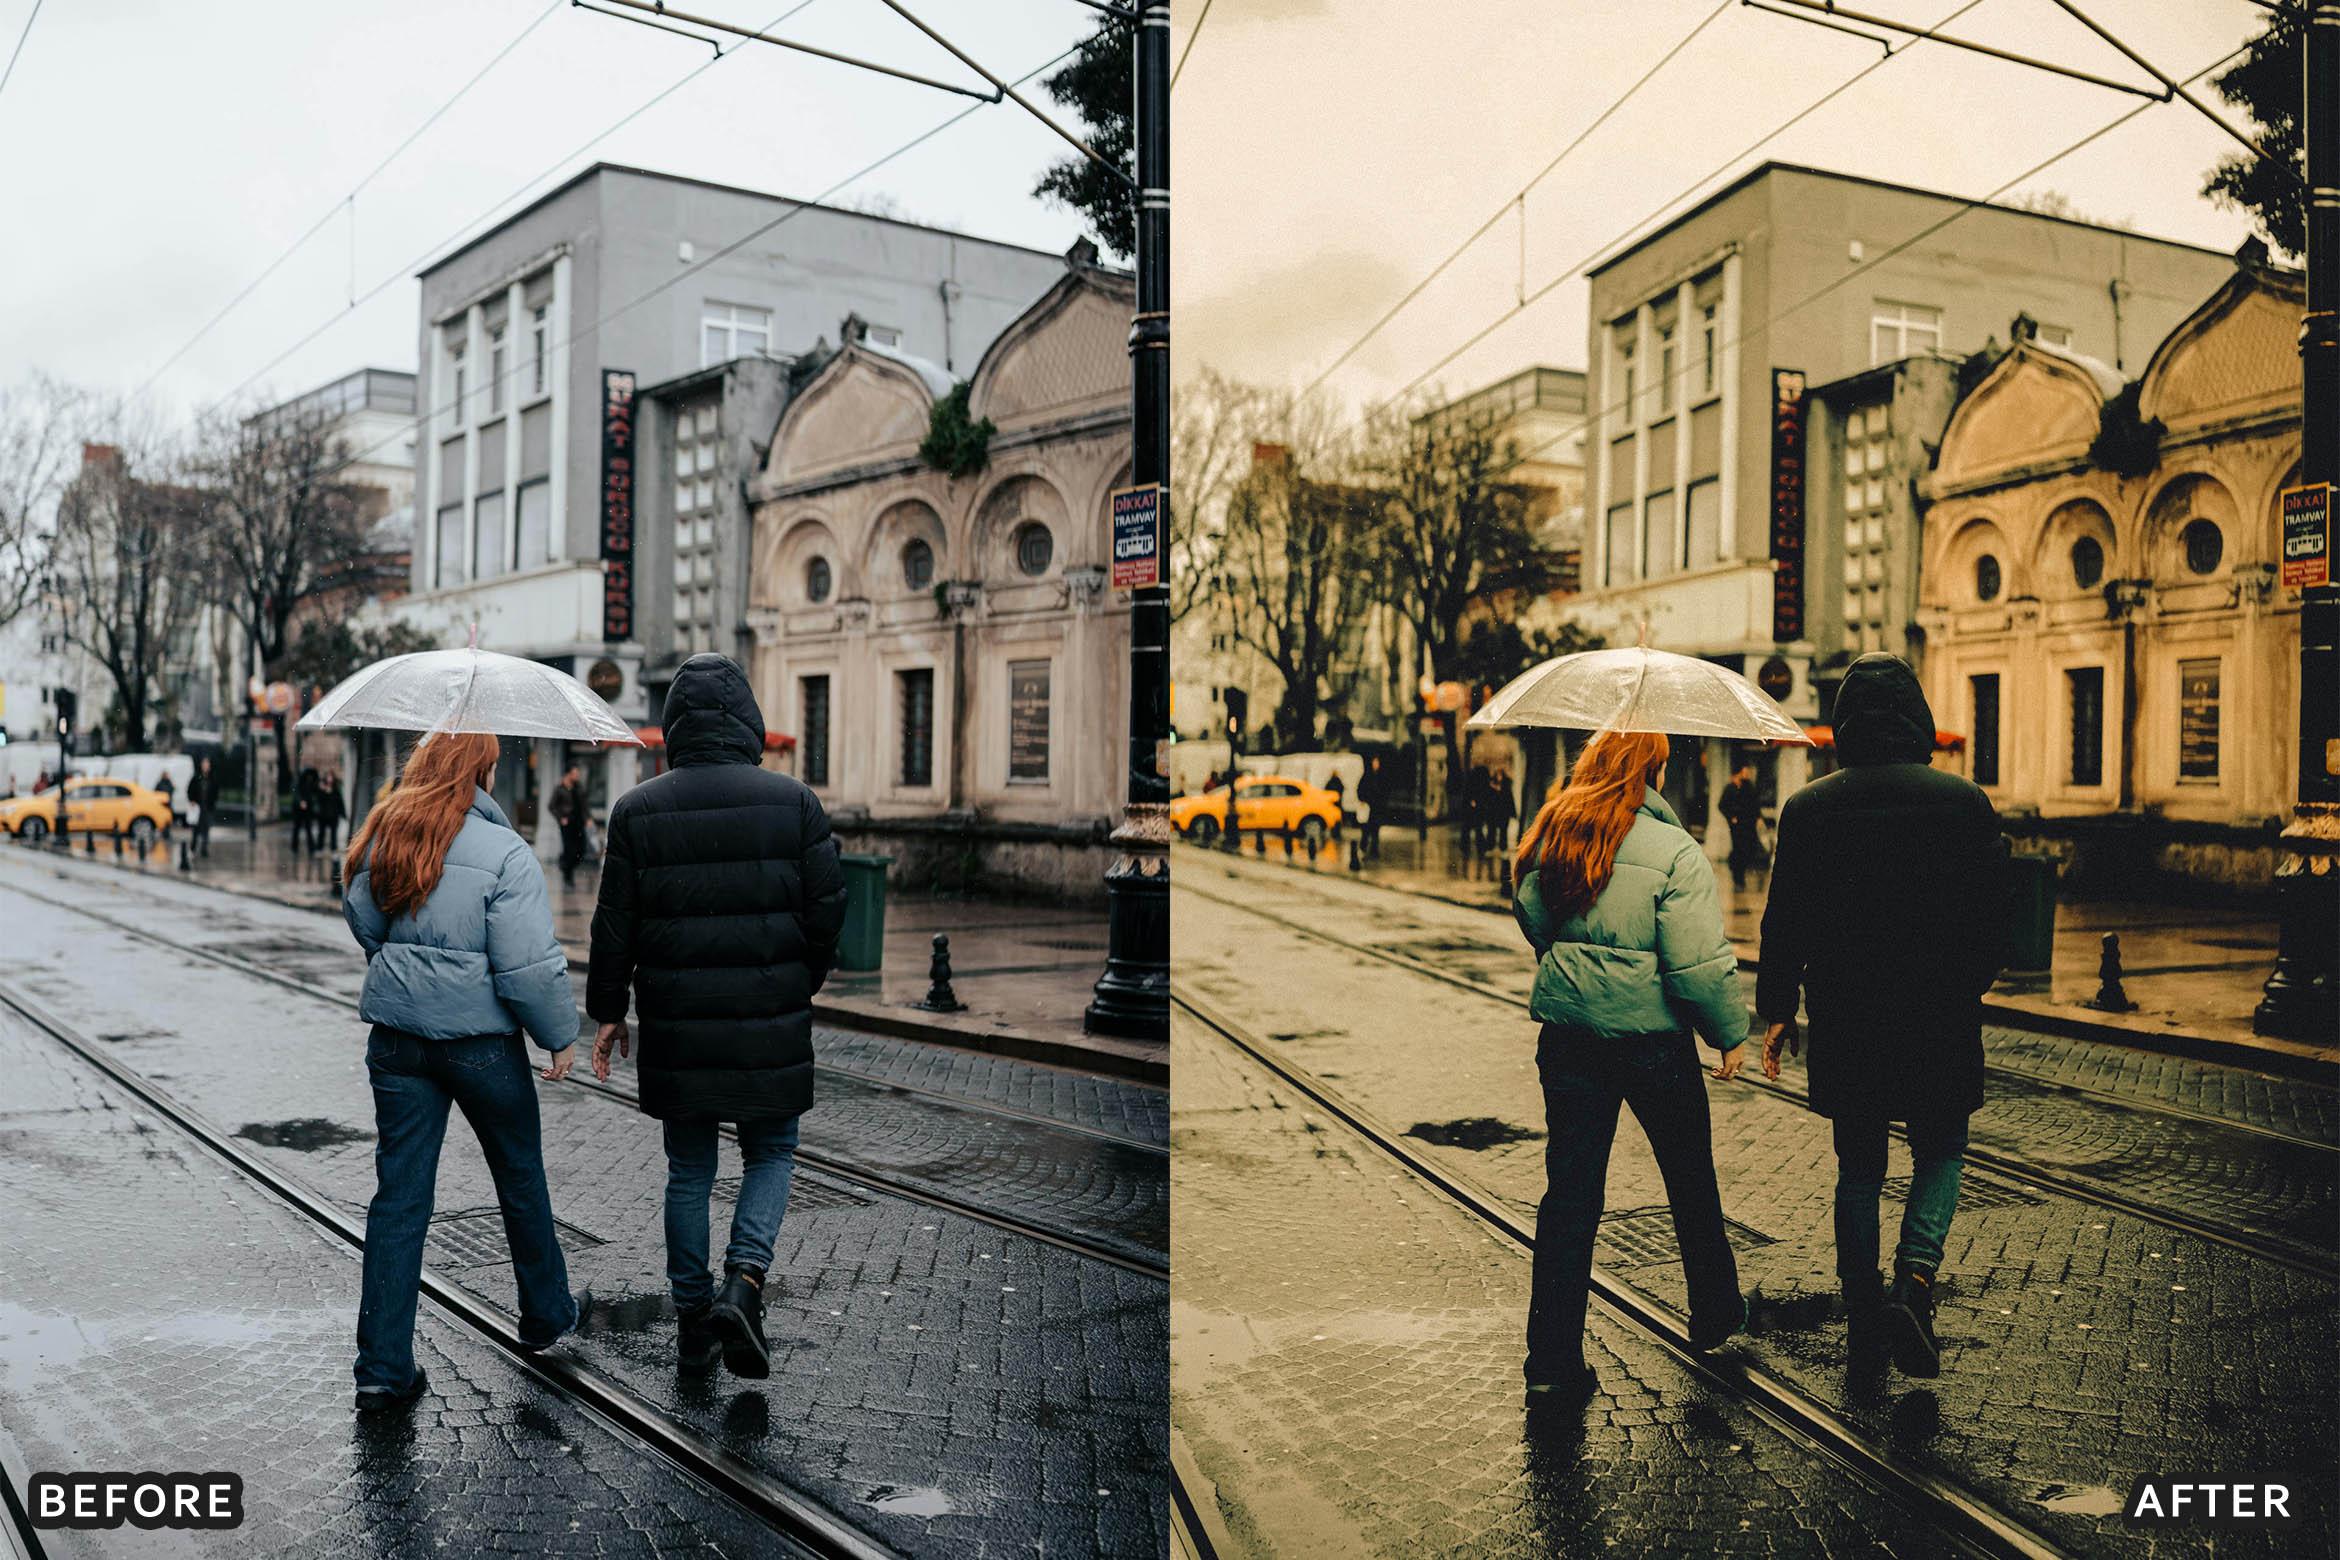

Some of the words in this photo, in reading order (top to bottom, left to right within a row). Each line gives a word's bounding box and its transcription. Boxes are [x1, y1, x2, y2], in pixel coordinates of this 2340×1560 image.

[1115, 493, 1156, 512] DİKKAT
[1115, 509, 1156, 528] TRAMVAY
[2285, 509, 2326, 527] TRAMVAY
